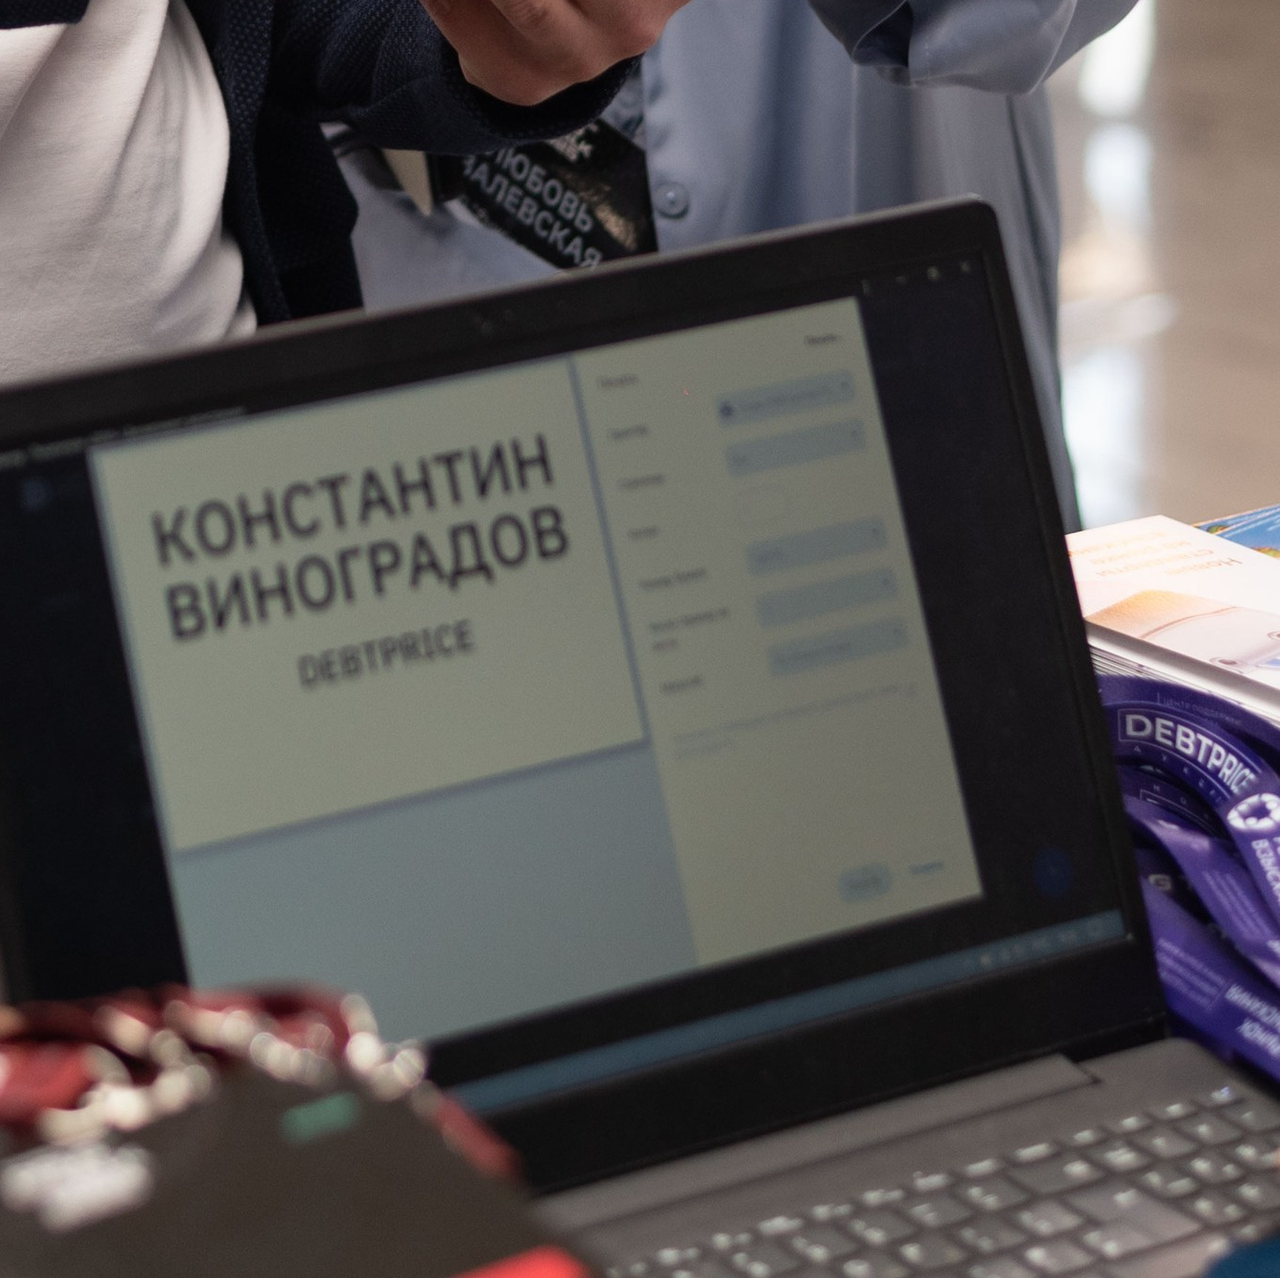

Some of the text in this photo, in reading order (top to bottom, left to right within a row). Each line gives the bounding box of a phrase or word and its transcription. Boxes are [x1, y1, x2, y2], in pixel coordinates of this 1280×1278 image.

[151, 433, 555, 568] КОНСТАНТИН
[163, 504, 571, 643] ВИНОГРАДОВ
[297, 619, 476, 691] DEBTPRICE
[1125, 713, 1258, 795] DEBTPRICE
